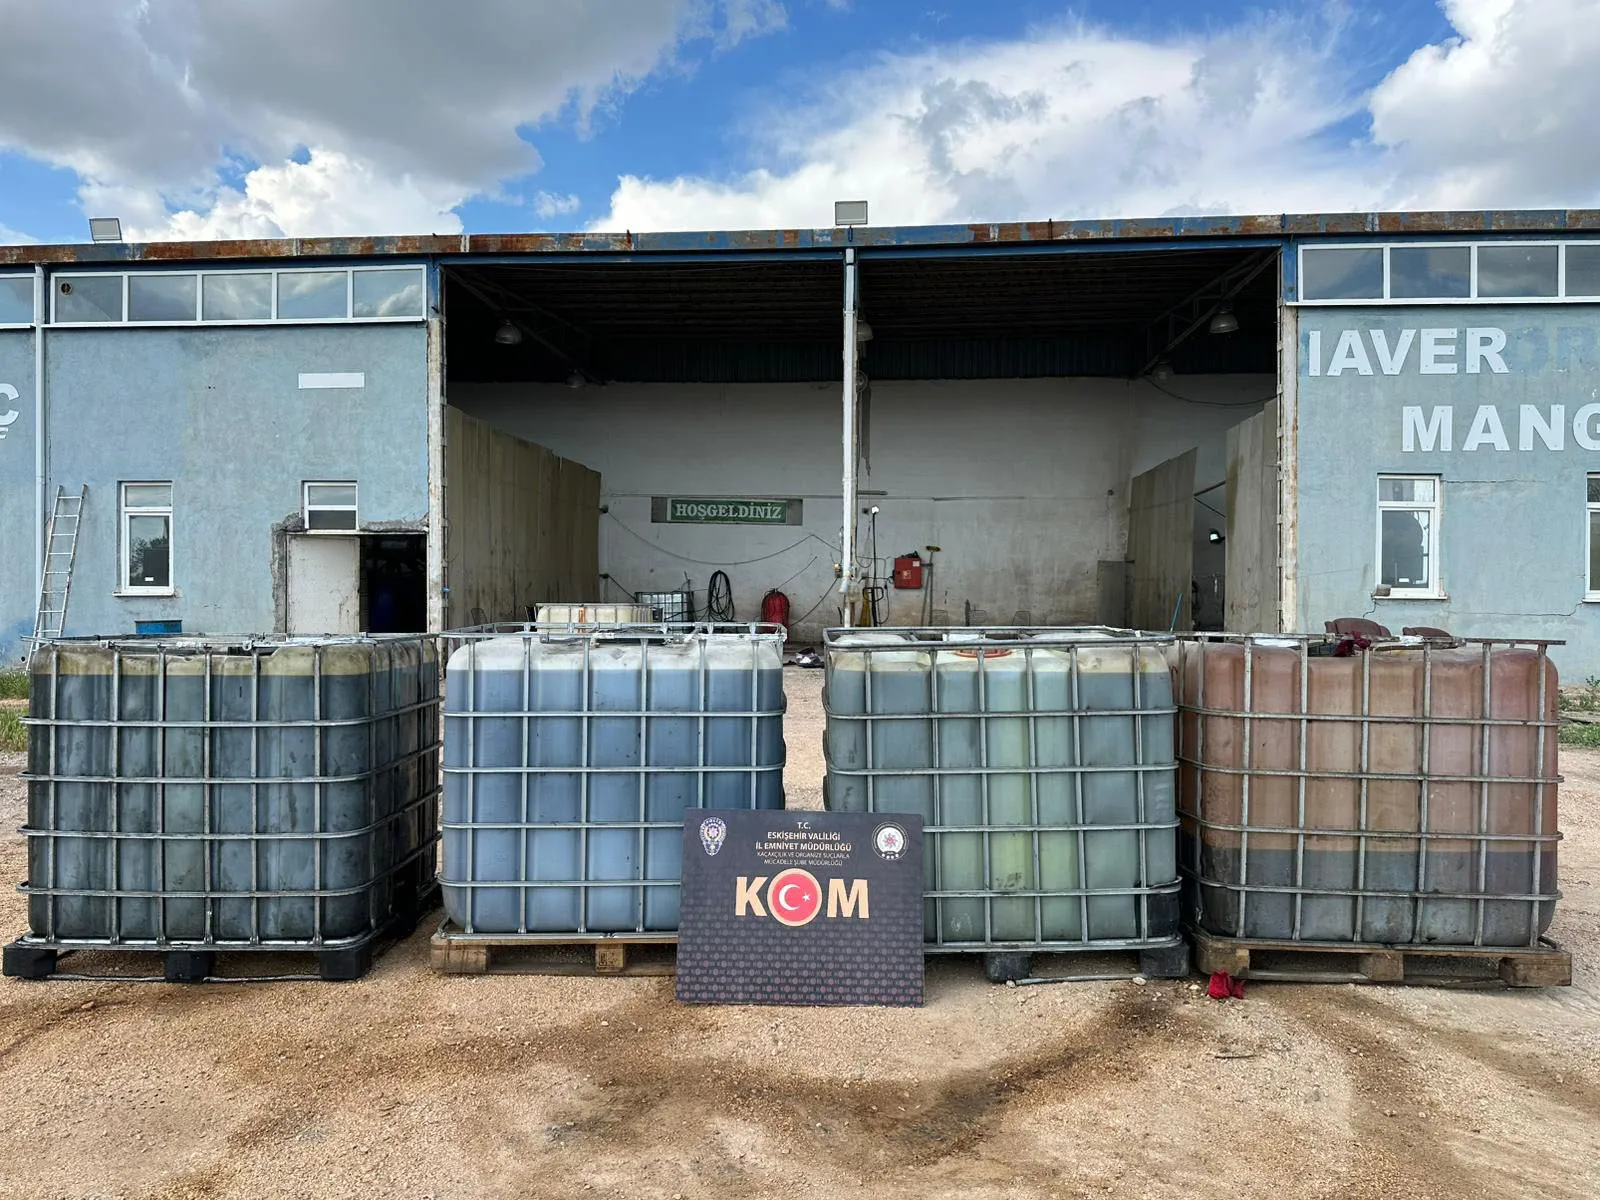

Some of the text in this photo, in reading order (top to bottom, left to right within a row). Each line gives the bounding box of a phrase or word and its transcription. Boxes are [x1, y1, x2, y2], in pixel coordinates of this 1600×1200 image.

[1308, 327, 1510, 377] IAVER
[797, 821, 811, 829] T.C.
[767, 831, 807, 841] ESKİŞEHİR
[755, 840, 852, 852] İL EMNİYET MÜDÜRLÜĞÜ
[735, 867, 870, 927] KOM
